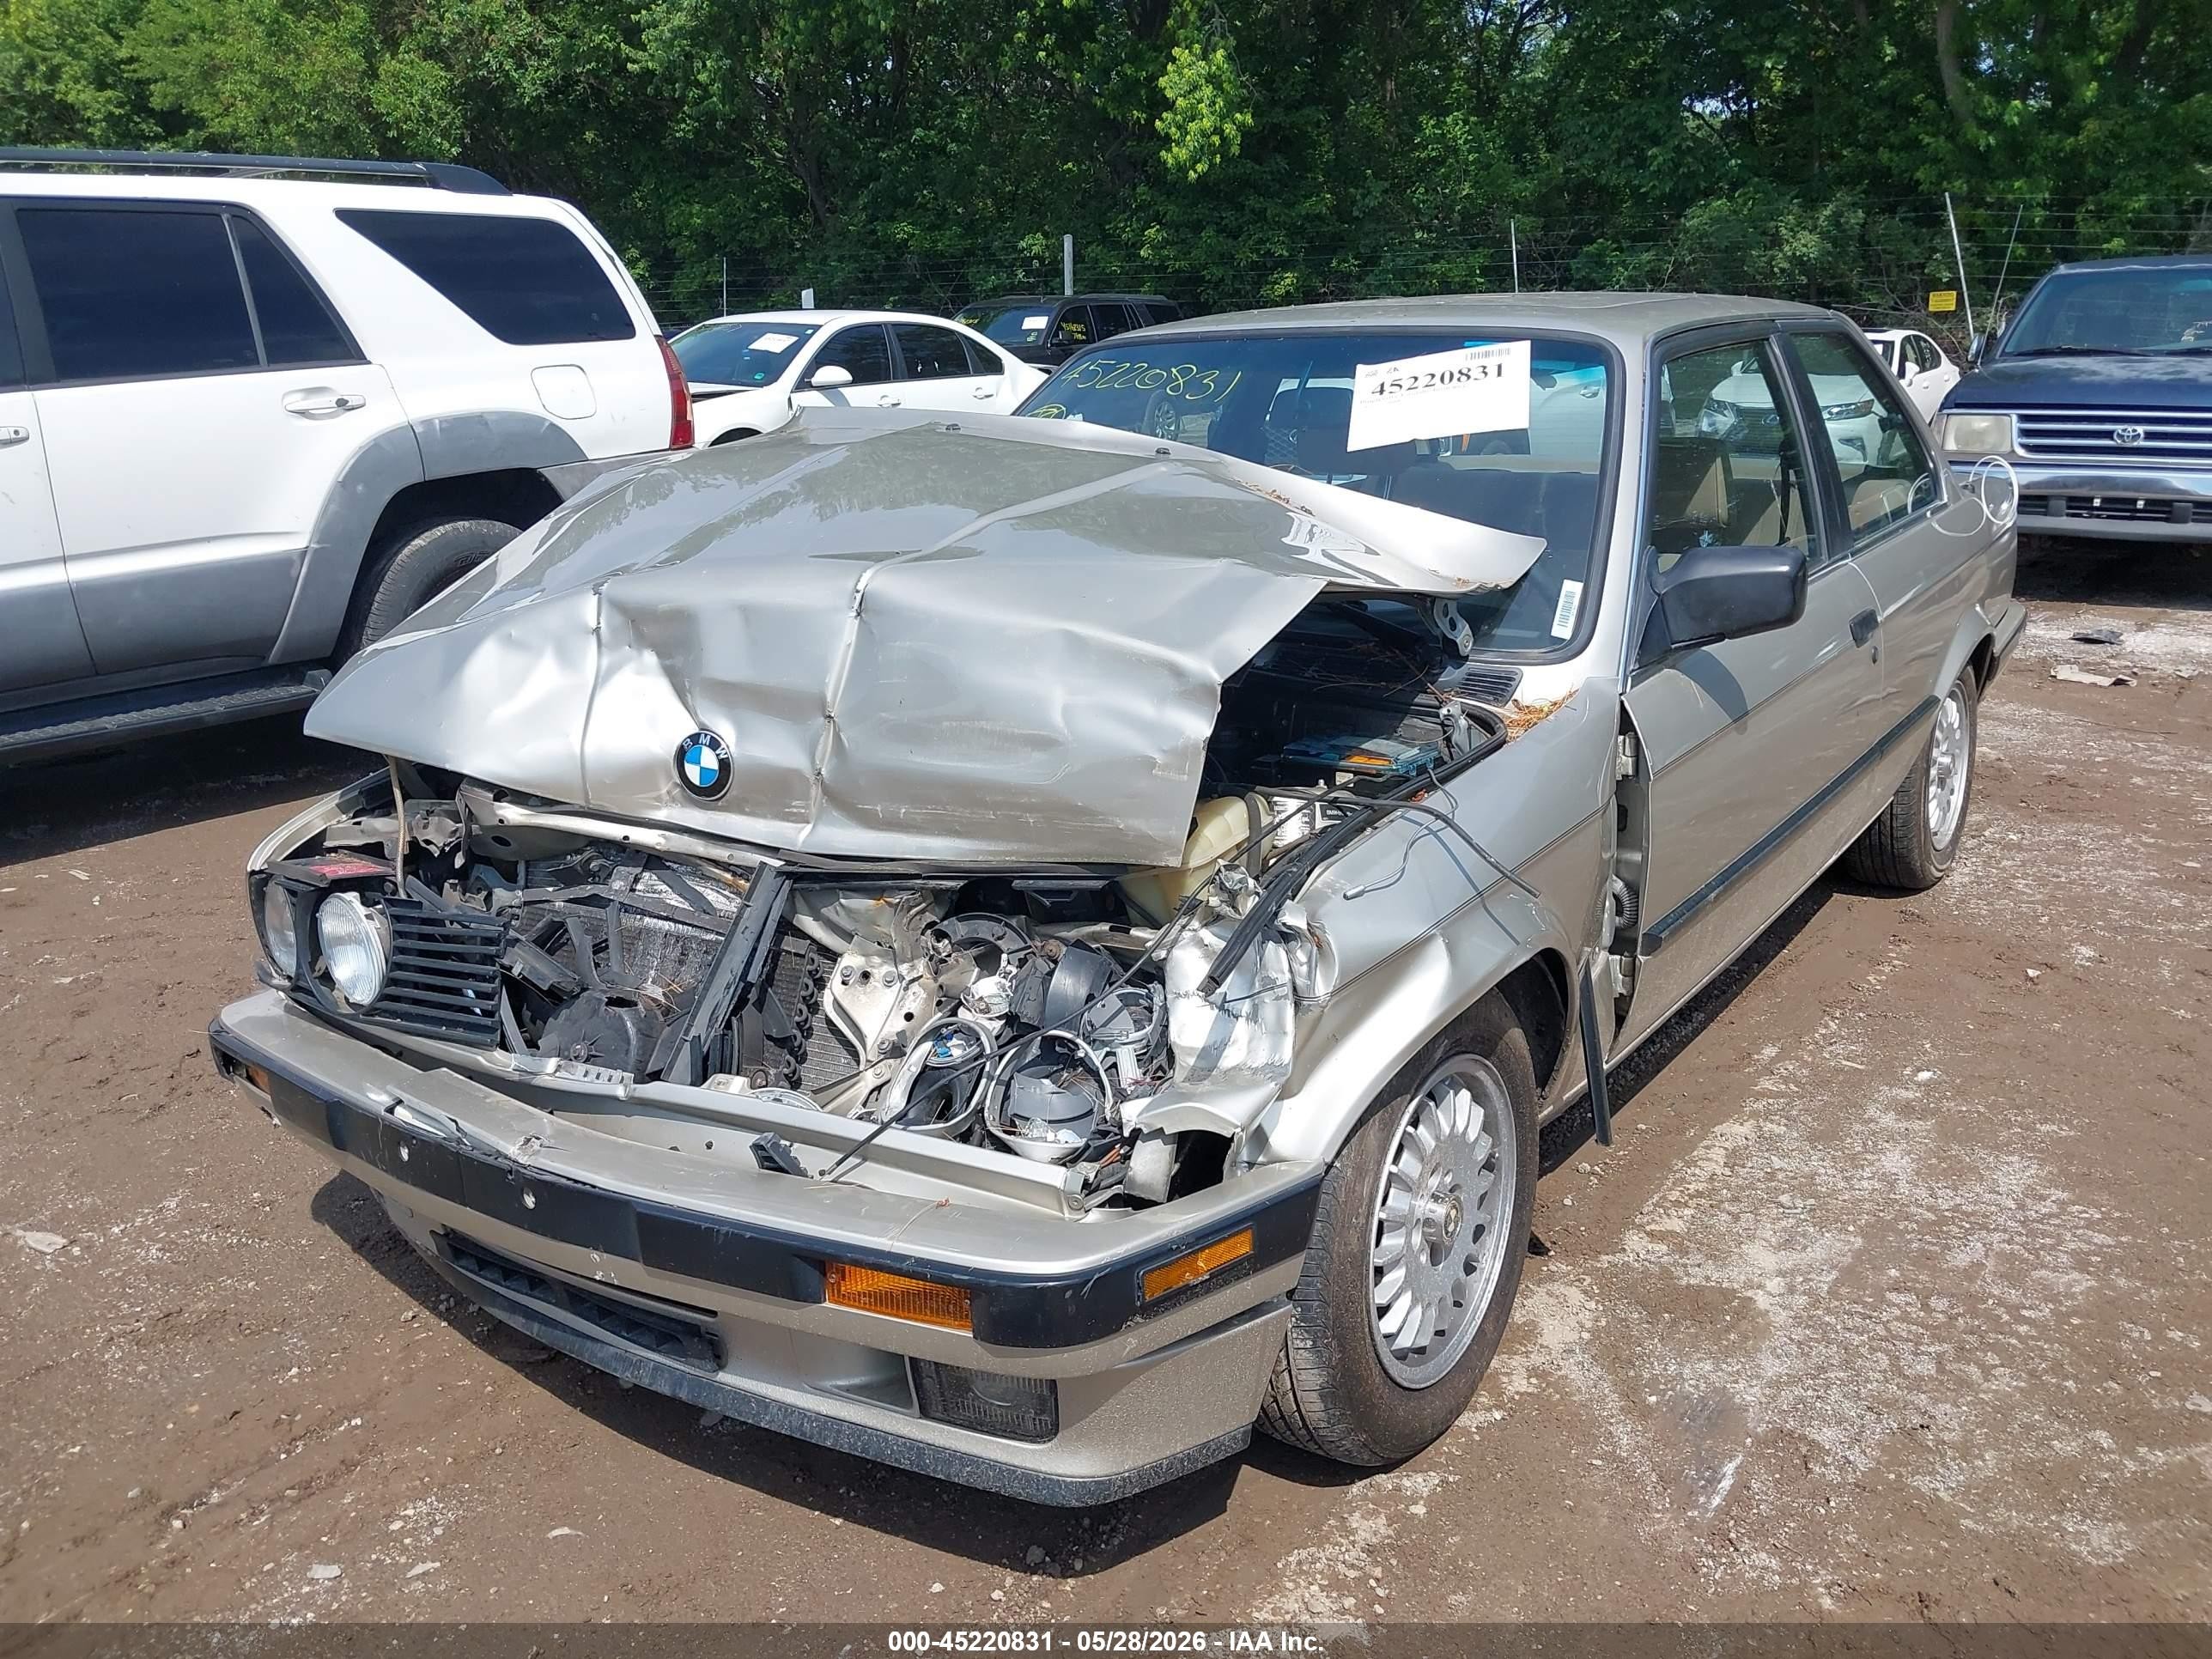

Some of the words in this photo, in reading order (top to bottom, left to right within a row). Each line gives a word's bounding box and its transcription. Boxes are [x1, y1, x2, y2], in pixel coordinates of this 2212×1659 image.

[1060, 359, 1243, 404] 45220831
[1371, 362, 1505, 397] 45220831
[682, 732, 729, 760] BMW
